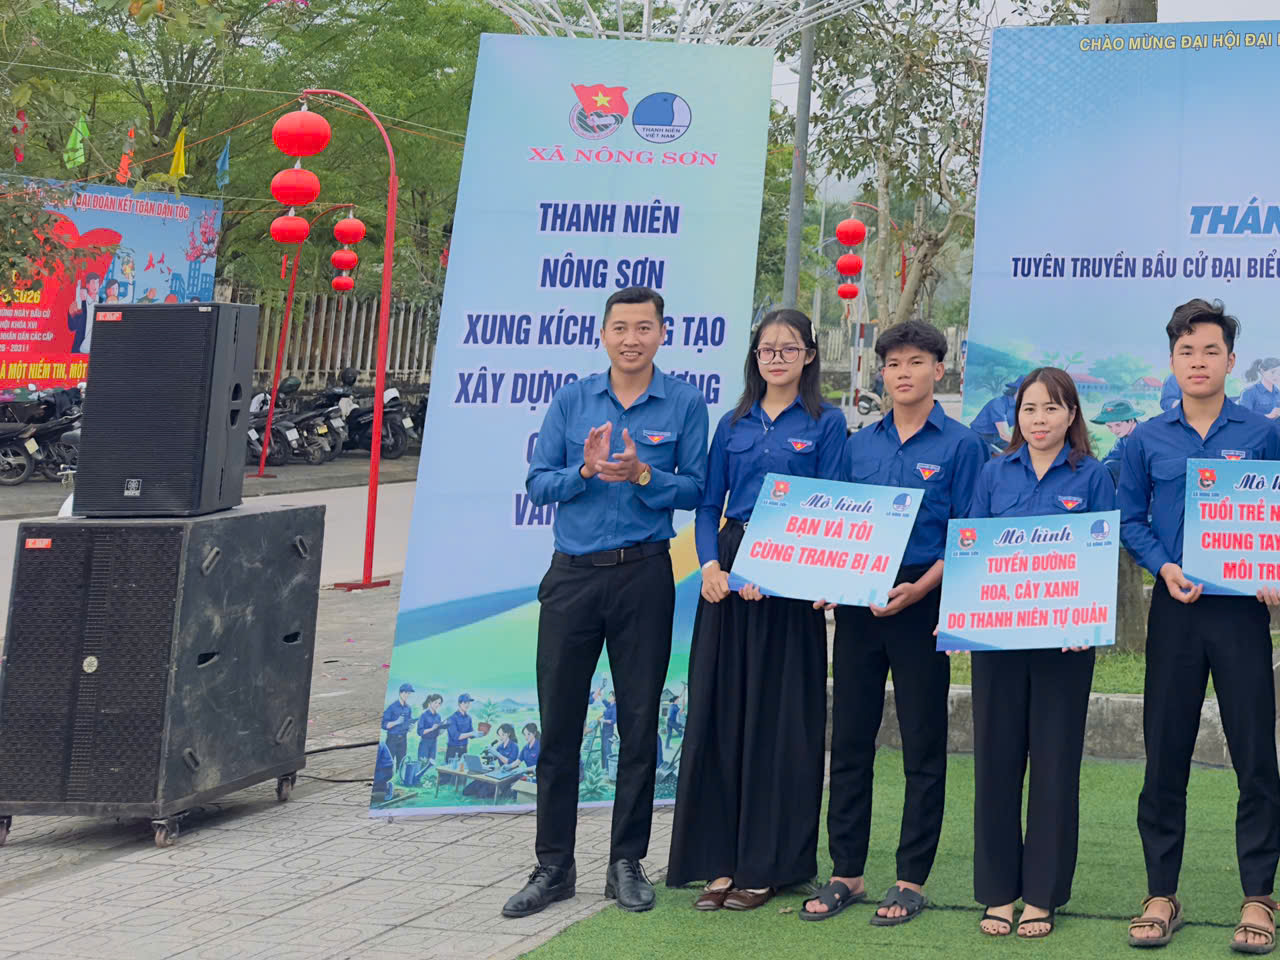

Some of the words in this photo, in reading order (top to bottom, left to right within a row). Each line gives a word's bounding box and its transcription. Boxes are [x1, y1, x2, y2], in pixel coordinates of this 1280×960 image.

[1080, 34, 1125, 52] CHÀO
[1128, 32, 1177, 51] MỪNG
[1181, 33, 1209, 51] ĐẠI
[1213, 29, 1240, 50] HỘI
[1245, 31, 1272, 50] ĐẠI
[528, 144, 566, 163] XÃ
[575, 146, 654, 164] NÔNG
[661, 150, 718, 166] SƠN
[93, 192, 116, 211] ĐOÀN
[117, 193, 134, 213] KẾT
[135, 197, 156, 215] TOÀN
[157, 200, 173, 218] DÂN
[174, 202, 190, 222] TỘC
[539, 203, 616, 233] THANH
[622, 200, 680, 234] NIÊN
[540, 253, 608, 289] NÔNG
[615, 259, 665, 289] SƠN
[1012, 252, 1065, 278] TUYÊN
[1071, 250, 1137, 278] TRUYỀN
[1142, 250, 1177, 278] BẦU
[1183, 250, 1208, 279] CỬ
[1211, 257, 1241, 283] ĐẠI
[463, 314, 532, 345] XUNG
[538, 309, 600, 349] KÍCH,
[683, 316, 725, 353] TẠO
[454, 366, 505, 404] XÂY
[1235, 473, 1265, 490] Mô
[801, 493, 831, 510] Mô
[834, 497, 874, 514] hình
[1199, 496, 1233, 520] TUỔI
[1238, 498, 1265, 521] TRẺ
[785, 516, 821, 538] BẠN
[823, 518, 844, 539] VÀ
[848, 520, 874, 542] TÔI
[994, 528, 1026, 545] Mô
[1031, 526, 1072, 543] hình
[1201, 532, 1254, 550] CHUNG
[798, 547, 849, 569] TRANG
[850, 552, 869, 575] BỊ
[870, 555, 890, 573] AI
[988, 551, 1028, 573] TUYẾN
[1032, 551, 1076, 571] ĐƯỜNG
[1223, 558, 1252, 580] MÔI
[980, 584, 1010, 602] HOA,
[1015, 580, 1040, 599] CÂY
[1043, 581, 1079, 598] XANH
[947, 613, 966, 629] DO
[970, 612, 1013, 629] THANH
[1016, 607, 1048, 627] NIÊN
[1052, 608, 1069, 629] TỰ
[1072, 601, 1108, 625] QUẢN
